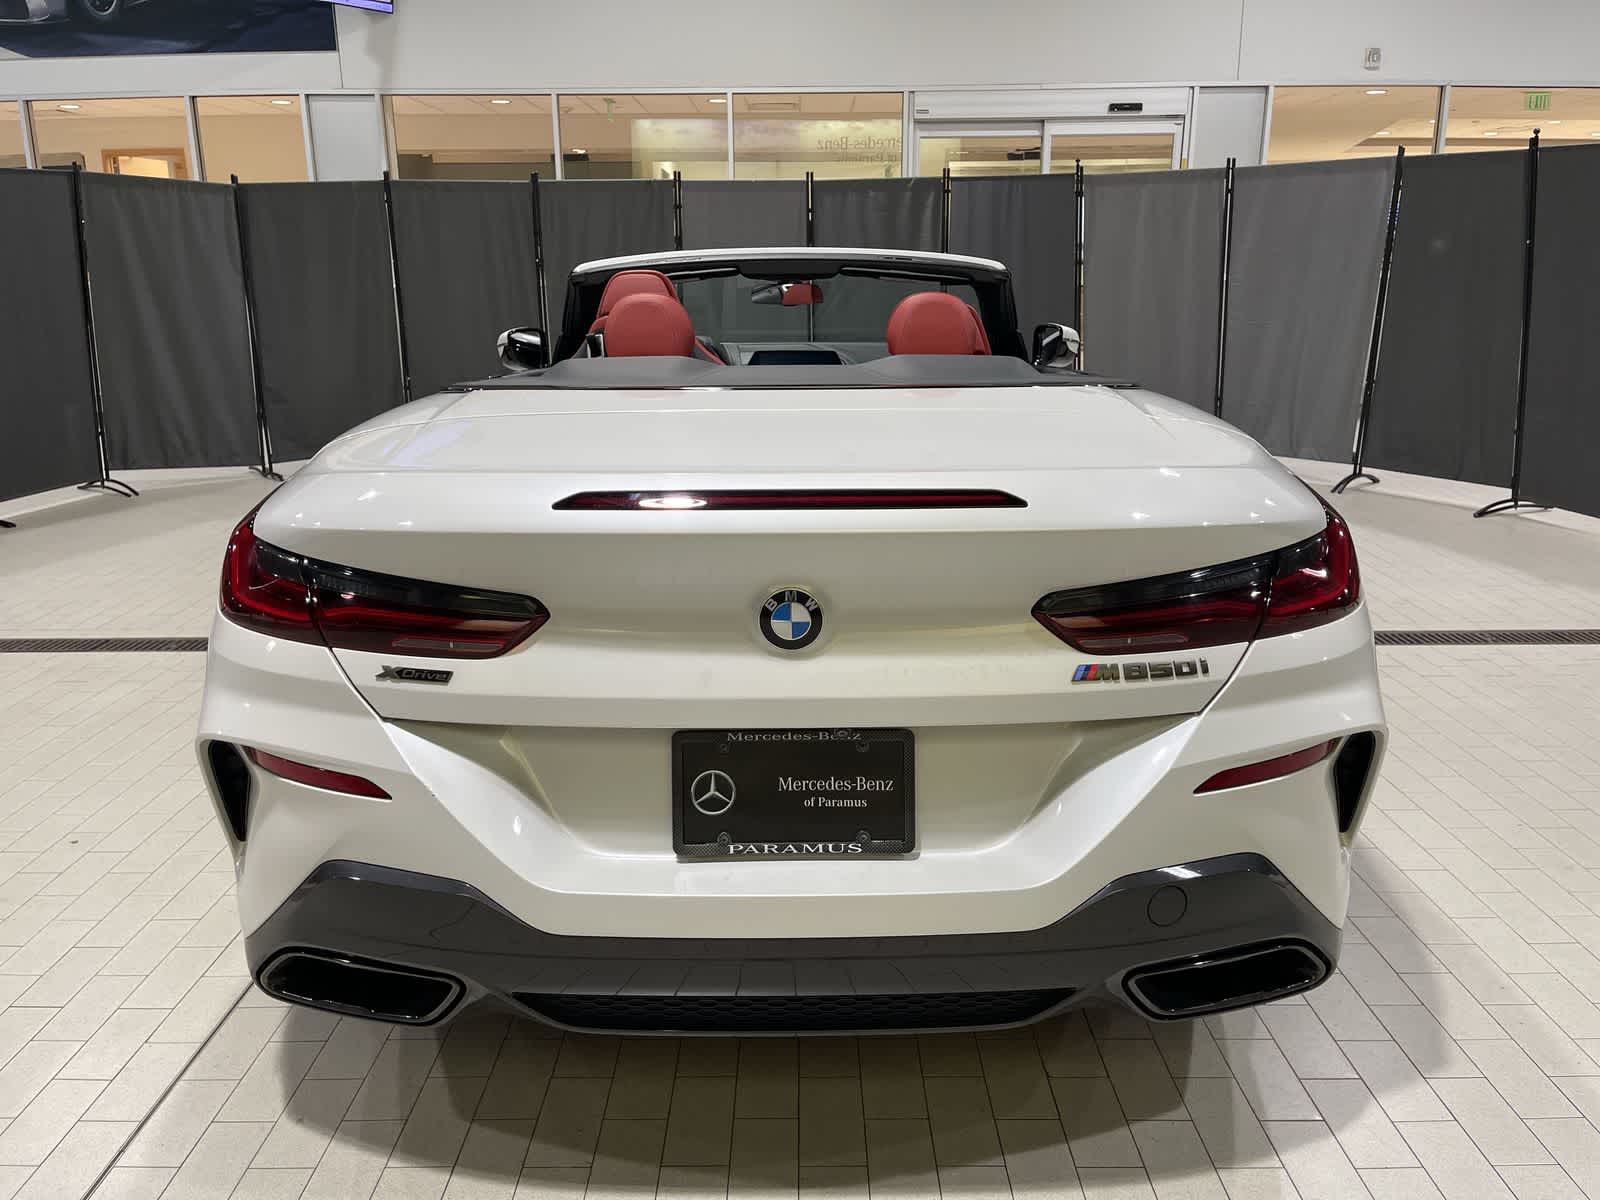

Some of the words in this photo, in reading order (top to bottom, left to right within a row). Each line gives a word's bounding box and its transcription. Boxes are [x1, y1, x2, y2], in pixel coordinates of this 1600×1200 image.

[765, 590, 818, 612] BMW
[727, 731, 862, 741] Mercedes-Bz
[778, 776, 894, 791] Mercedes-Benz
[804, 797, 815, 807] of
[818, 797, 867, 807] Paramus
[728, 843, 863, 854] PARAMUS
